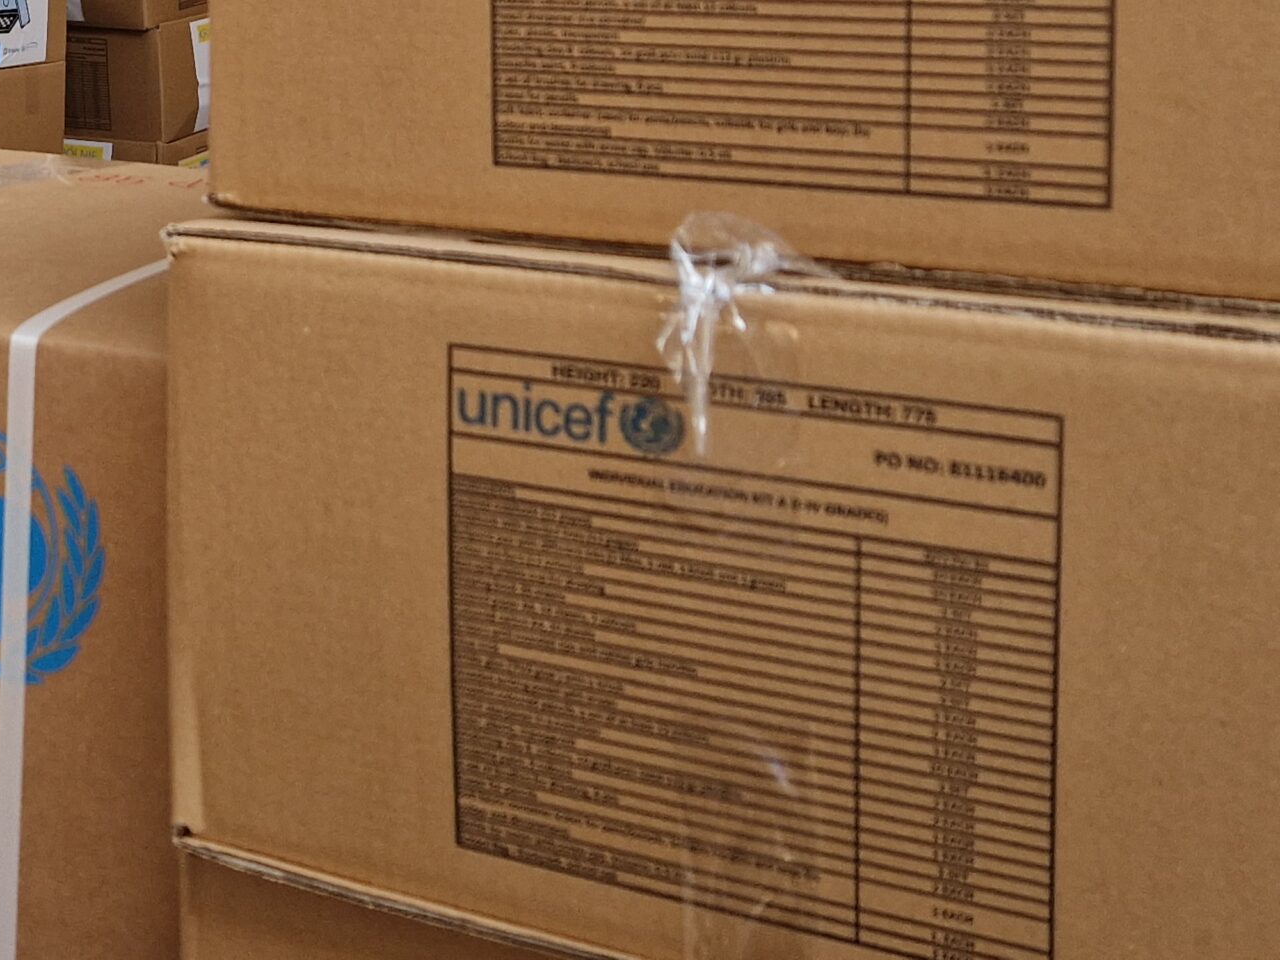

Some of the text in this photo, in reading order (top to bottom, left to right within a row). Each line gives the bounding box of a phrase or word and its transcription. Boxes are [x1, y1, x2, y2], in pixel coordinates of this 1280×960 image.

[457, 383, 616, 444] unicef
[551, 366, 625, 386] HEIGHT:
[806, 395, 897, 420] LENGTH:
[873, 450, 902, 471] PO
[588, 468, 664, 489] INDIVIDUAL
[668, 480, 749, 500] EDUCATION
